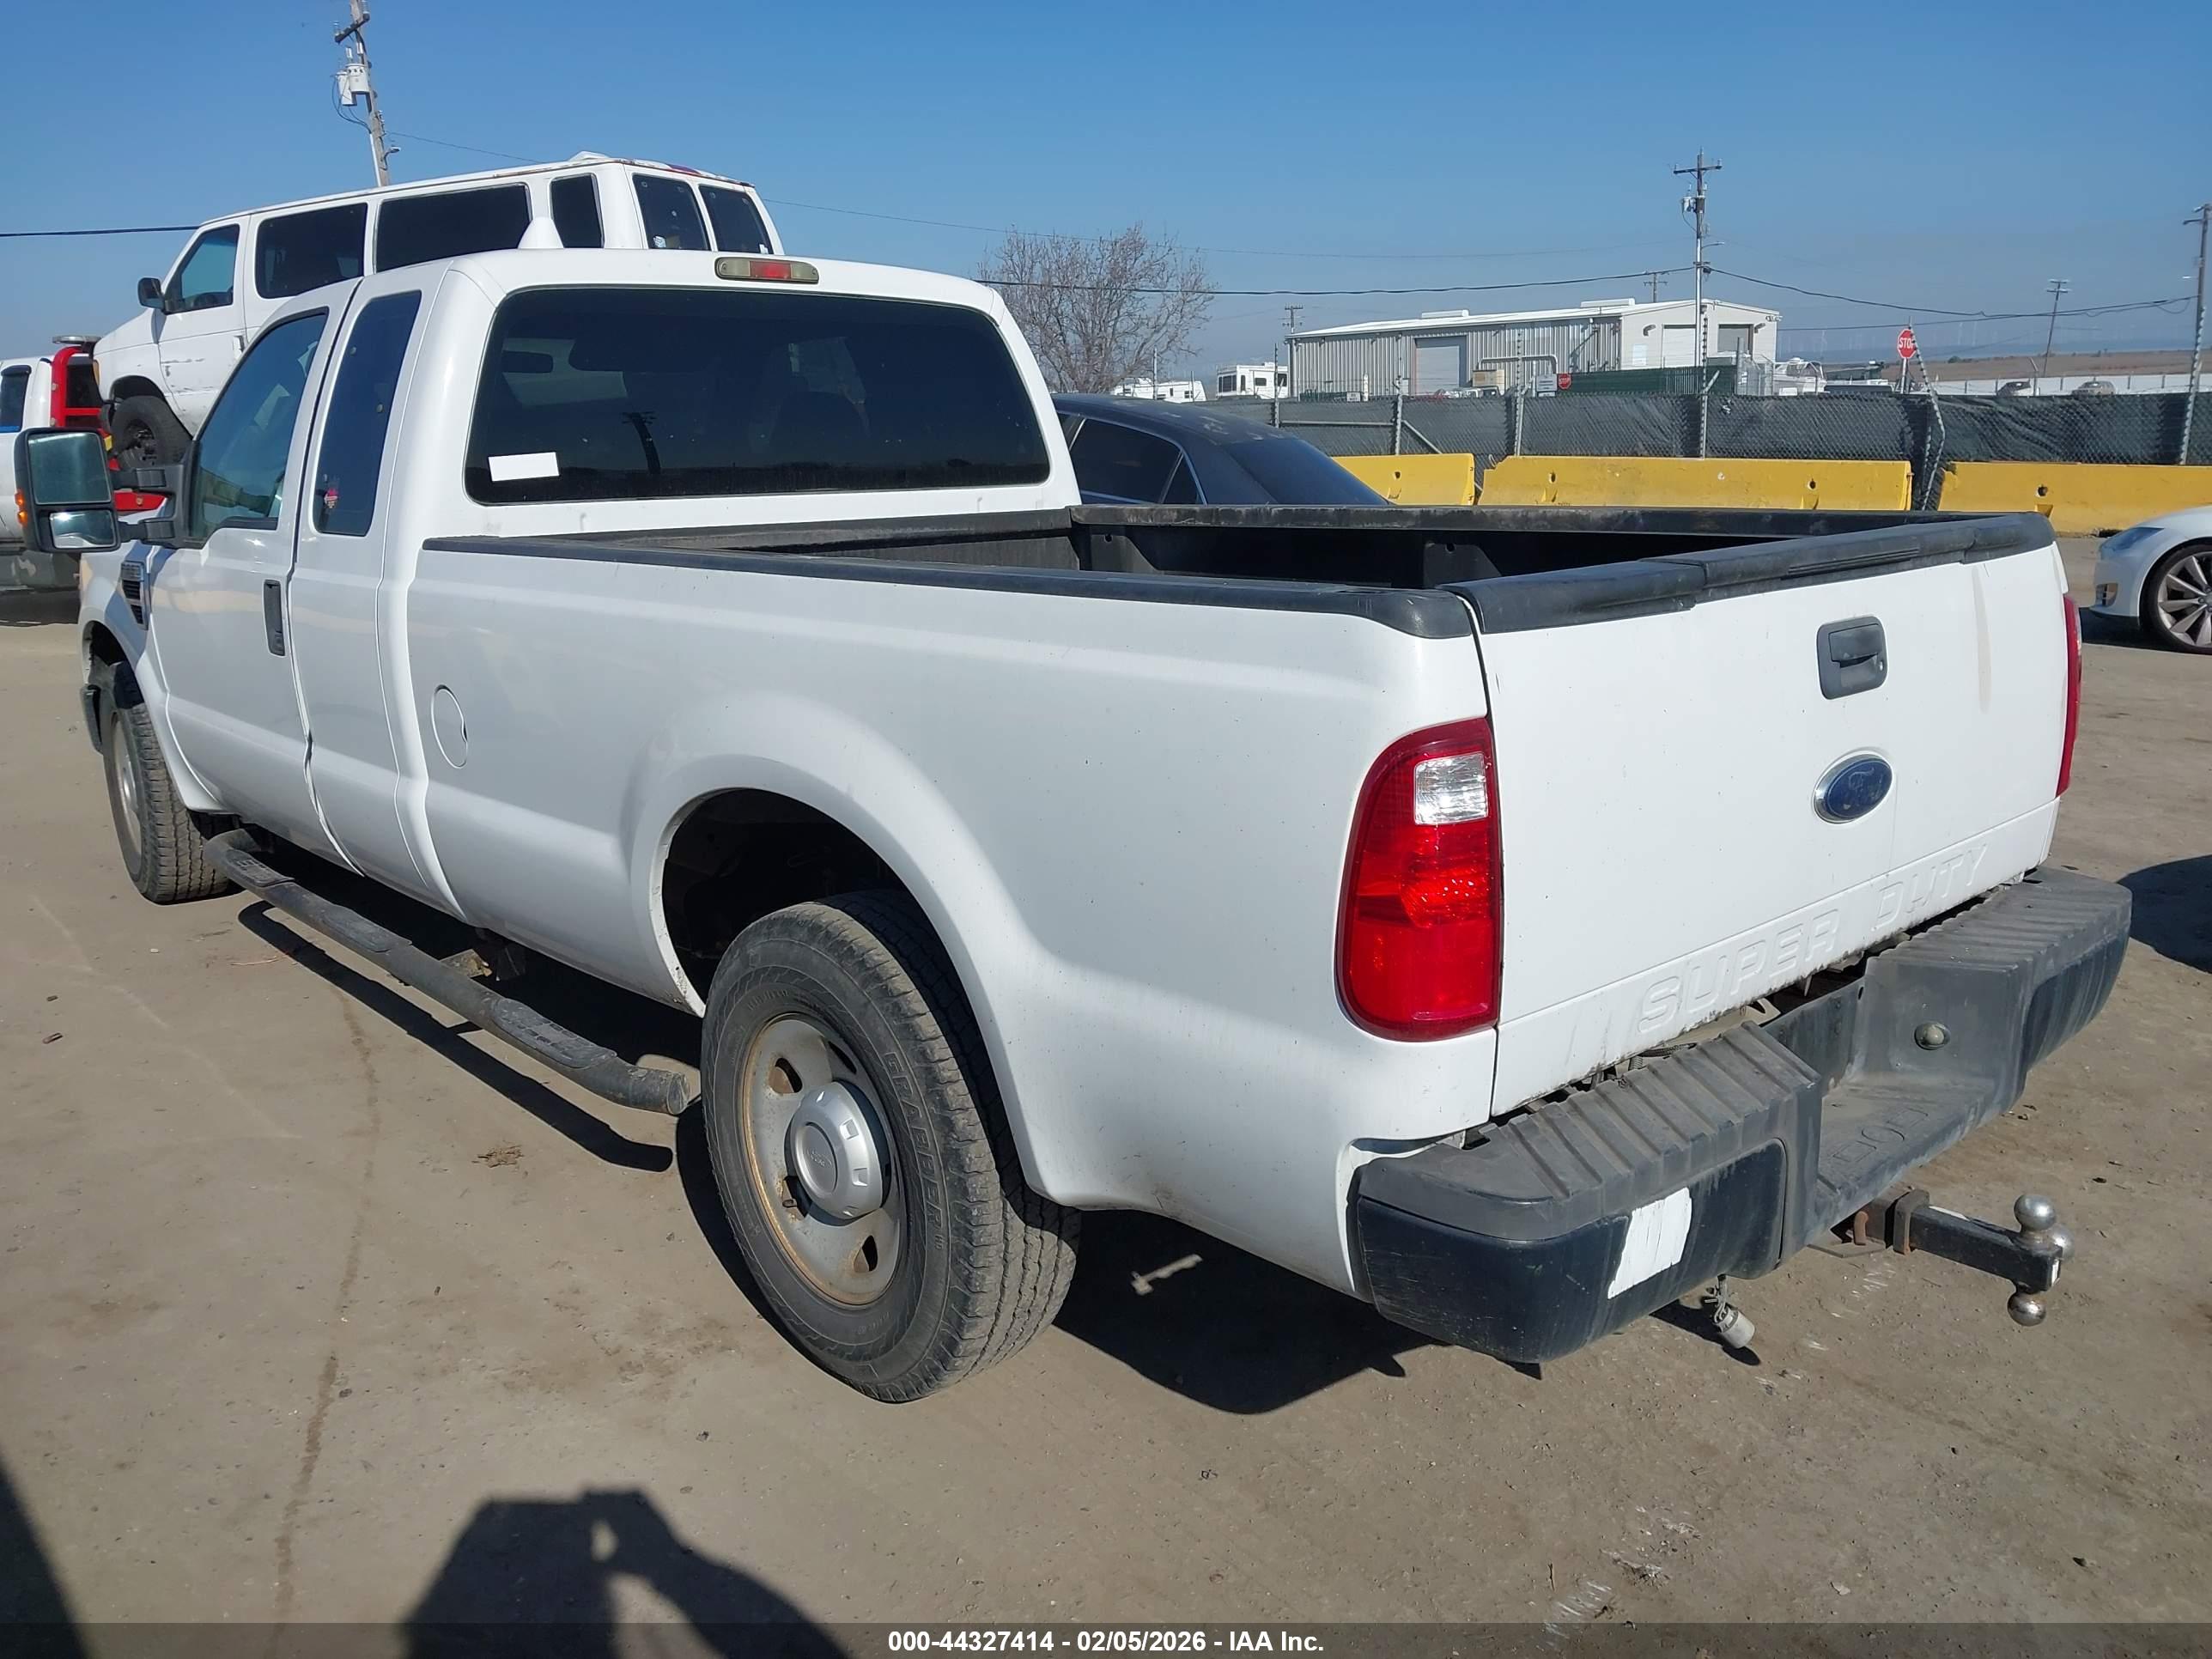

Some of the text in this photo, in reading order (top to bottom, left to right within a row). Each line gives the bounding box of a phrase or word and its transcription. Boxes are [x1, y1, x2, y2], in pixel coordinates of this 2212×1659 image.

[1638, 844, 1989, 1033] SUPER DUTY
[884, 1051, 943, 1231] GRABBER
